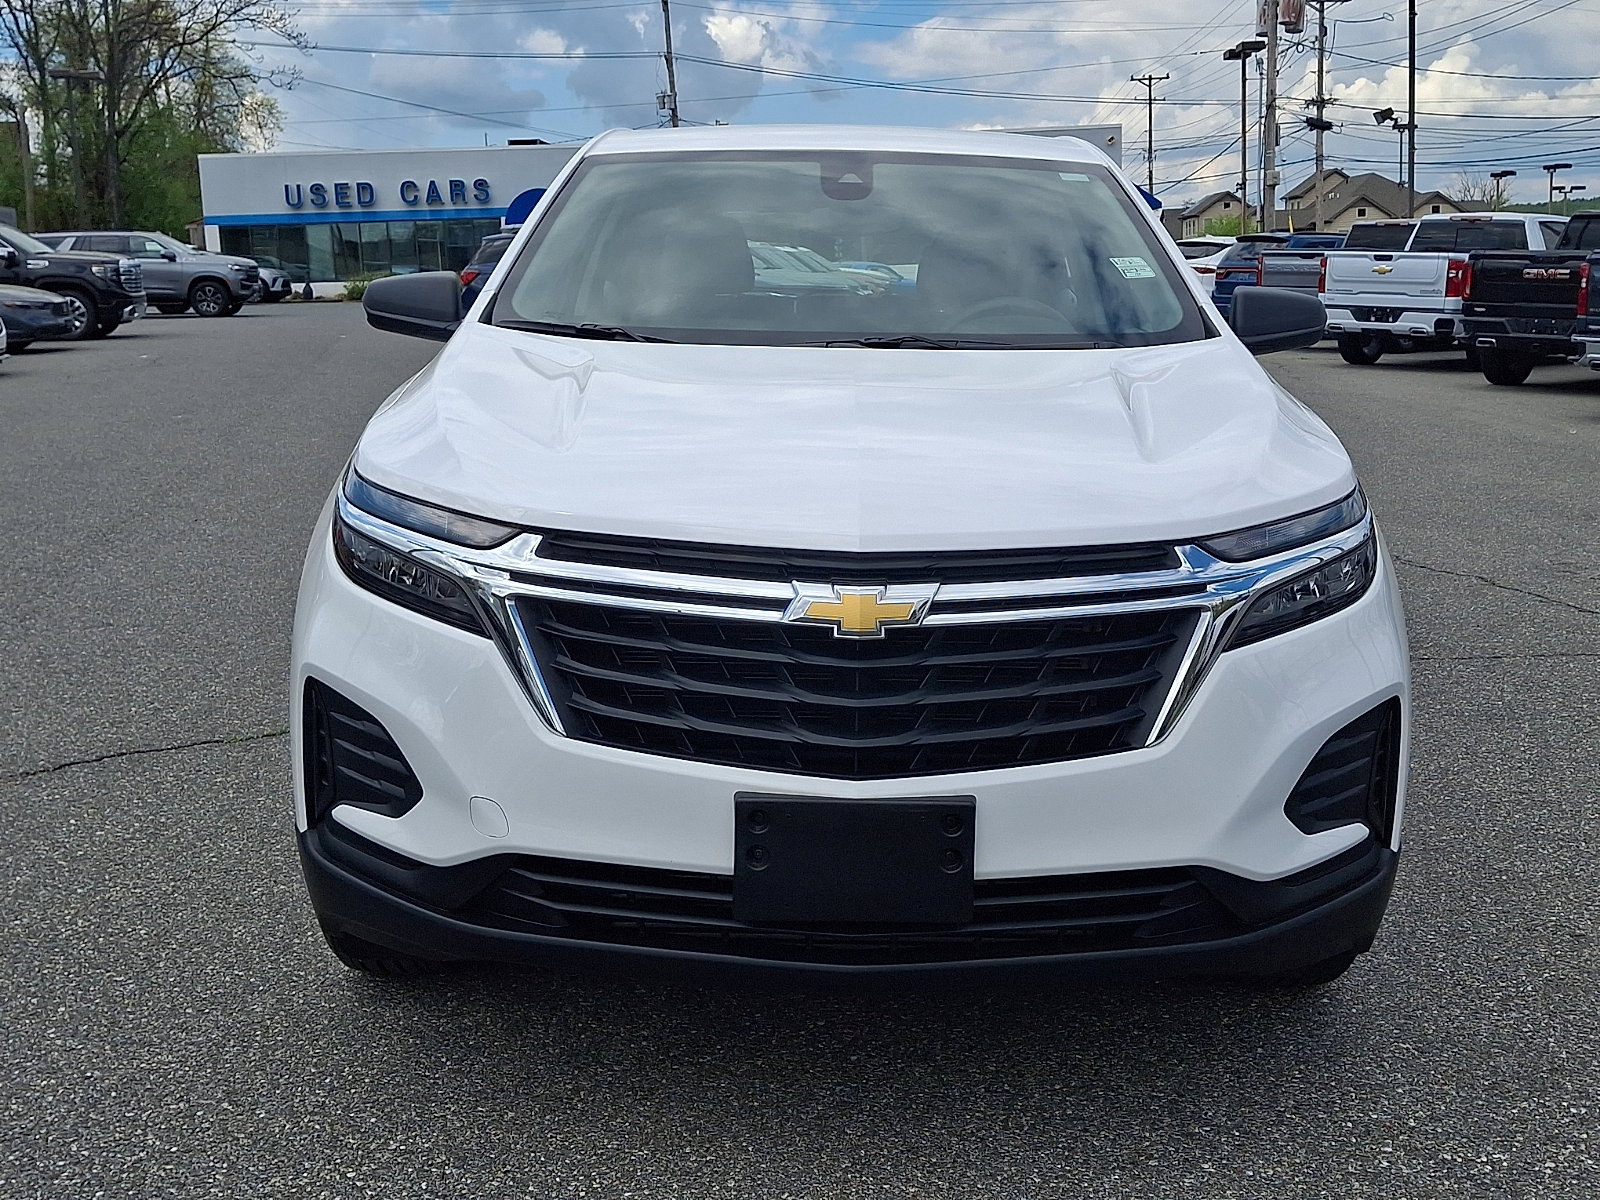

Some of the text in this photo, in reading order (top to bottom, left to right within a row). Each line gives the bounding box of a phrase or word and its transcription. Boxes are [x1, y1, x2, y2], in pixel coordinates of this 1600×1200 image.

[284, 178, 491, 207] USED CARS
[1522, 268, 1570, 279] GMC
